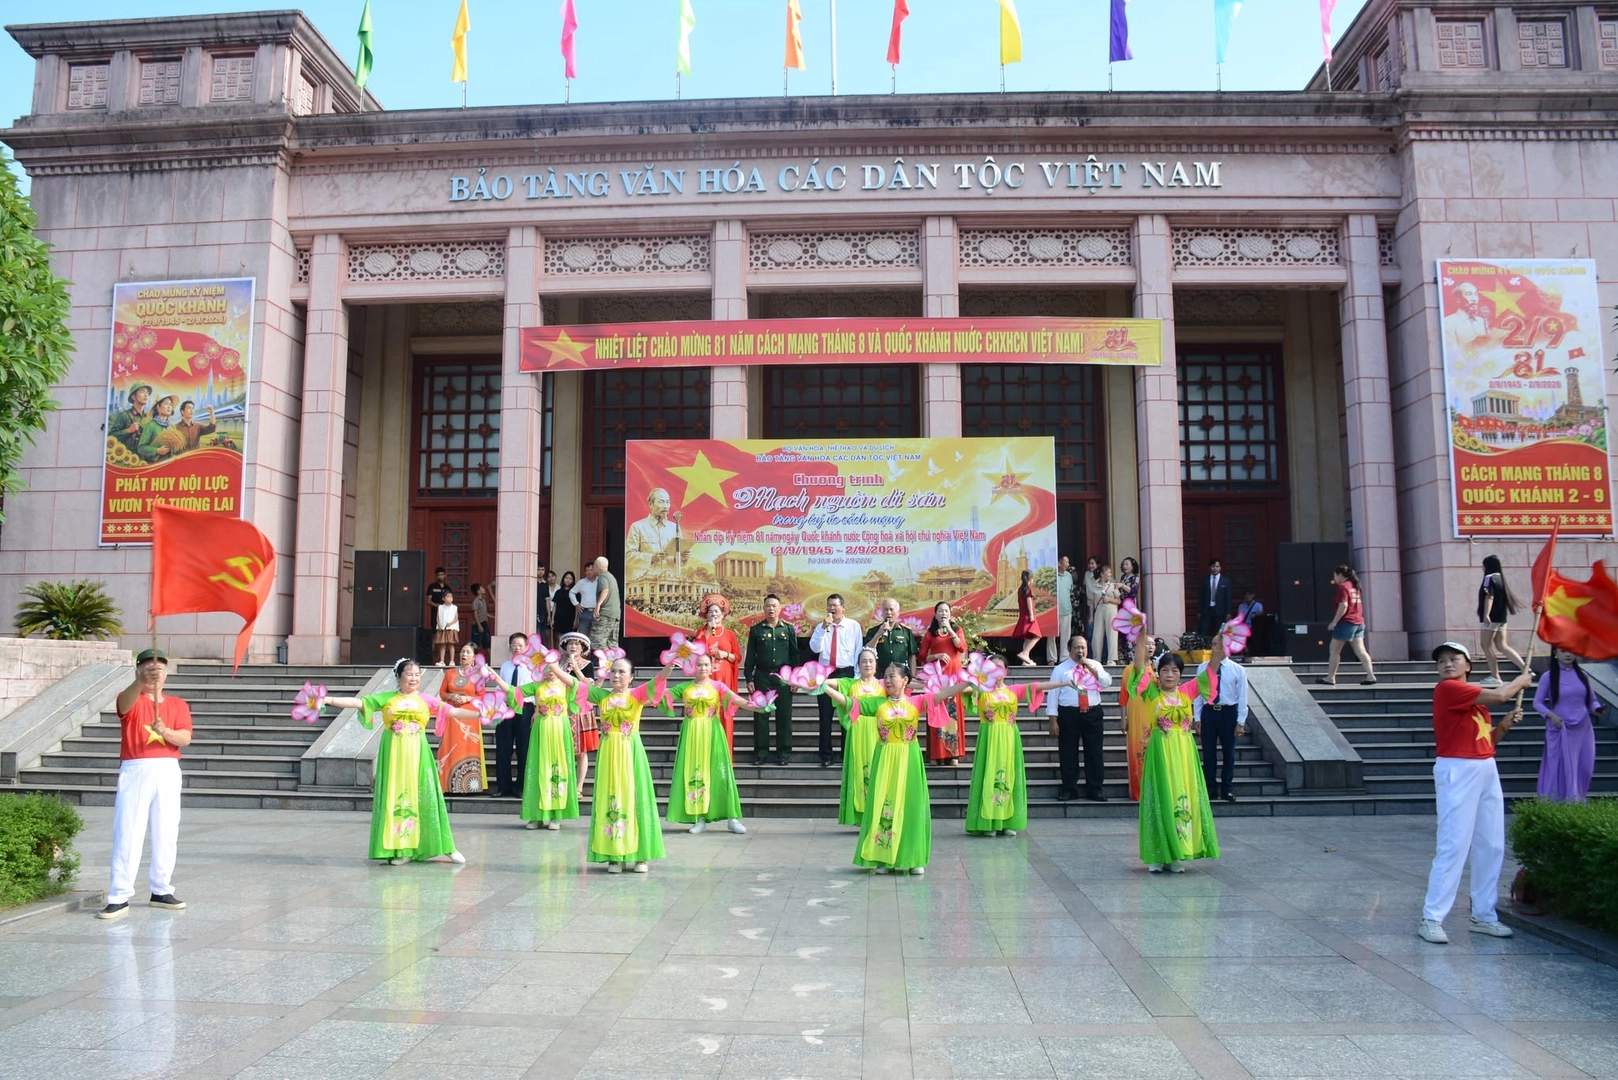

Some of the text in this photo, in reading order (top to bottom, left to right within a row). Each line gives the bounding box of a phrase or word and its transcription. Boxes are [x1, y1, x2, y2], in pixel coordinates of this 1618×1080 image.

[450, 154, 1223, 200] BẢO TÀNG VĂN HÓA CÁC DÂN TỘC VIỆT NAM
[136, 298, 227, 318] QUỐC KHÁNH
[1501, 316, 1565, 349] 2/9
[595, 324, 1085, 364] NHIỆT LIỆT CHÀO MỪNG 81 NĂM CÁCH MẠNG THÁNG 8 VÀ QUỐC KHÁNH NƯỚC CHXHCN VIỆT NAM!
[1513, 349, 1545, 378] 81
[115, 474, 229, 494] PHÁT HUY NỘI LỰC
[1461, 463, 1602, 484] CÁCH MẠNG THÁNG 8
[109, 497, 142, 512] VƯƠN
[214, 497, 234, 511] LAI
[733, 486, 810, 513] Mạch
[814, 490, 876, 513] nguồn
[1462, 484, 1505, 505] QUỐC
[1510, 485, 1565, 503] KHÁNH
[1568, 489, 1579, 503] 2
[1593, 489, 1604, 503] 9
[770, 545, 833, 556] (2/9/1945
[845, 545, 909, 555] 2/9/2026)
